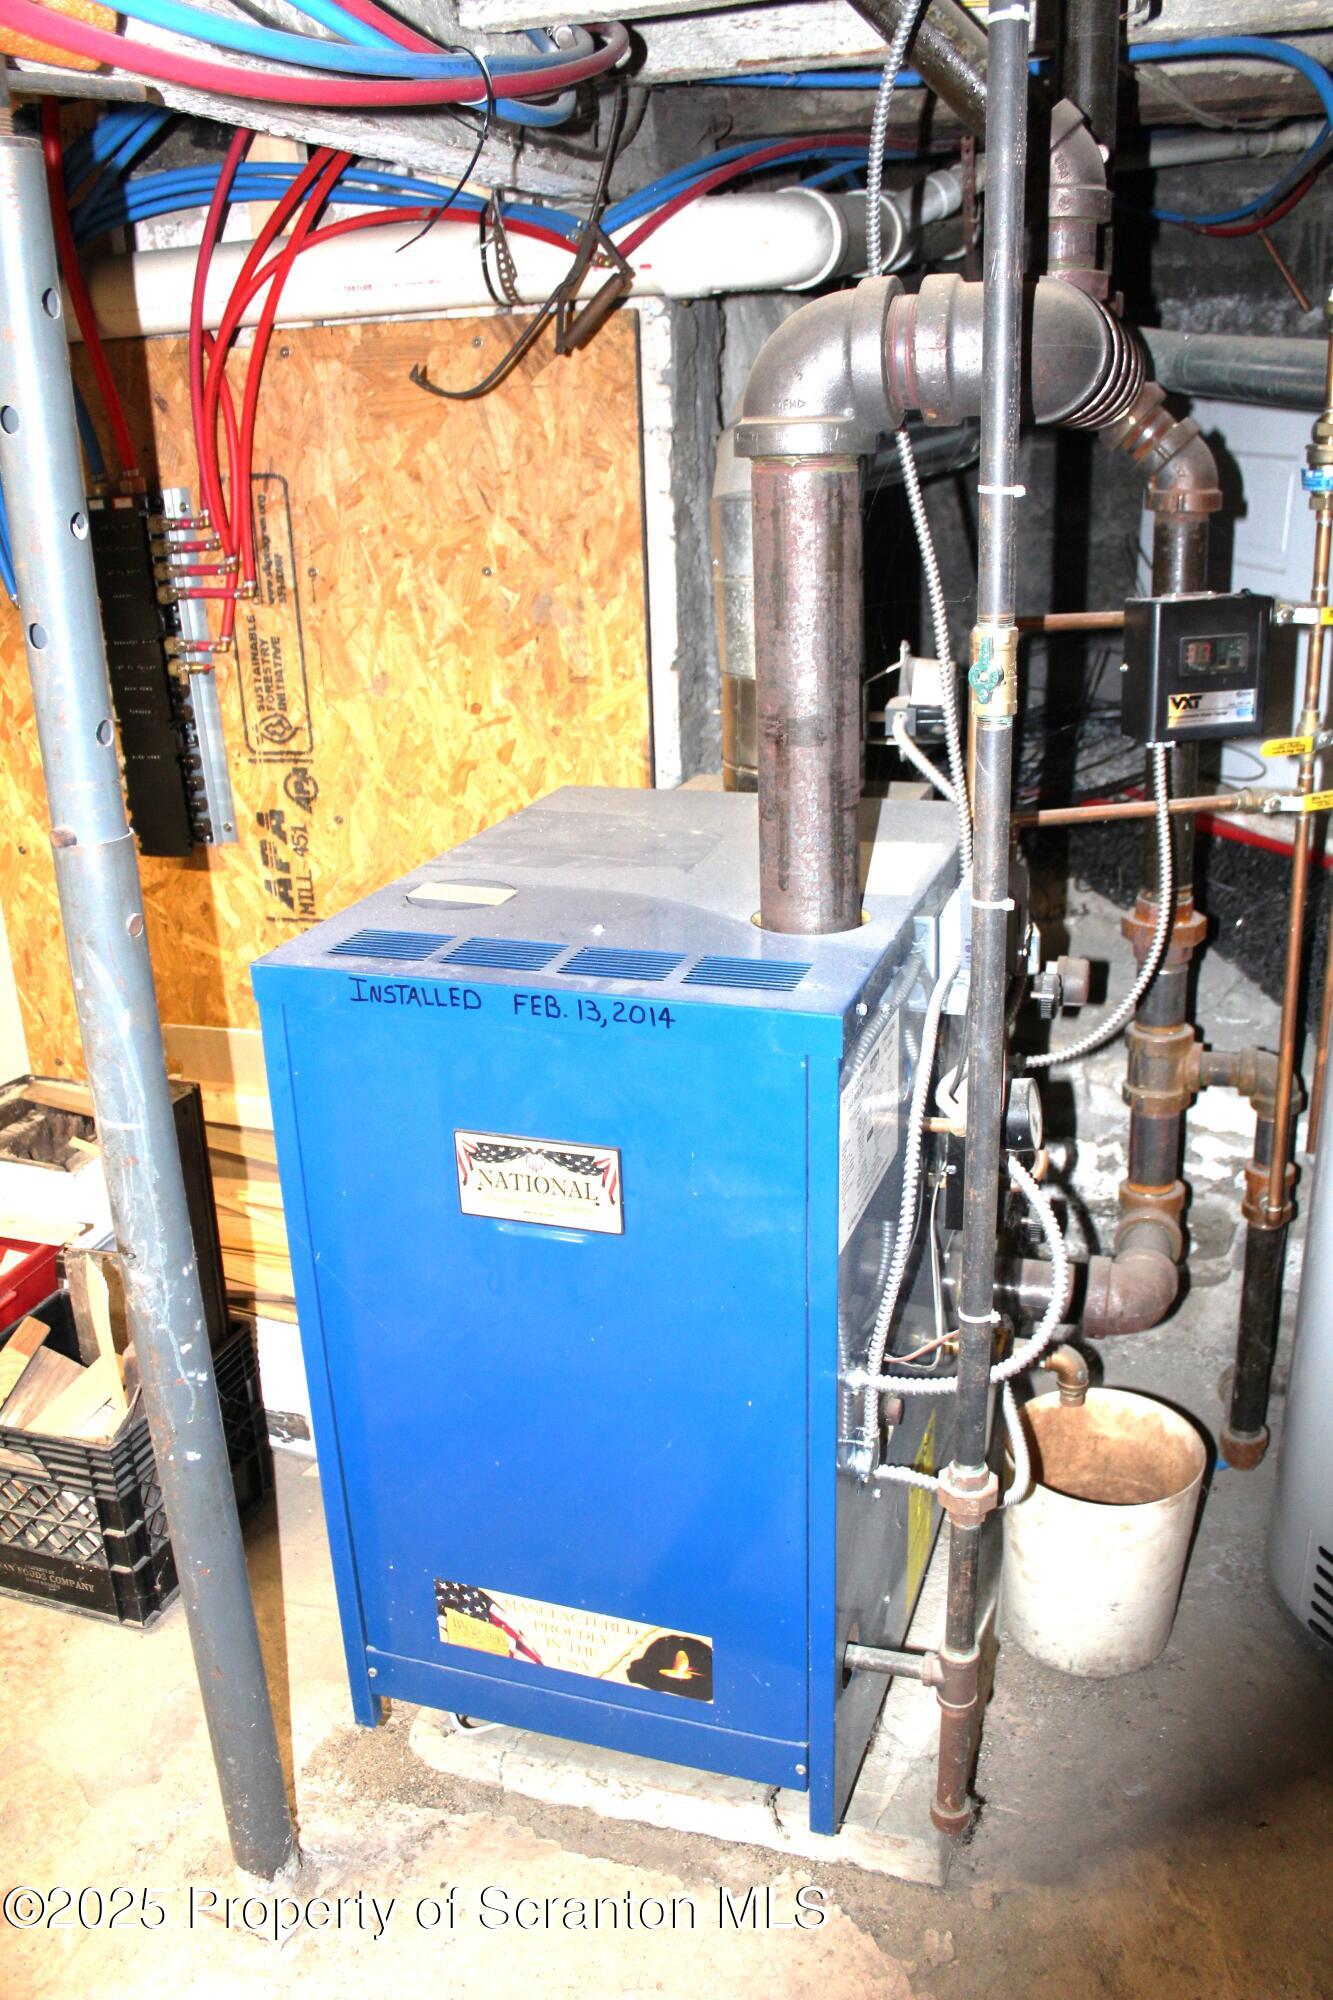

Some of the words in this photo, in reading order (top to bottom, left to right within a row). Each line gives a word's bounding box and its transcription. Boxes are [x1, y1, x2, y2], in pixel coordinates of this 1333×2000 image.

[247, 614, 265, 713] SUSTAINABLE
[258, 636, 275, 712] FORESTRY
[270, 635, 287, 713] INITIATIVE
[1170, 695, 1203, 710] VXT
[291, 766, 313, 815] APA
[256, 808, 294, 913] AFA
[290, 823, 308, 859] 451
[296, 868, 316, 916] MILL
[349, 976, 482, 1011] INSTALLED
[513, 993, 568, 1019] FEB.
[477, 1168, 599, 1201] NATIONAL
[49, 1575, 95, 1593] COMPANY
